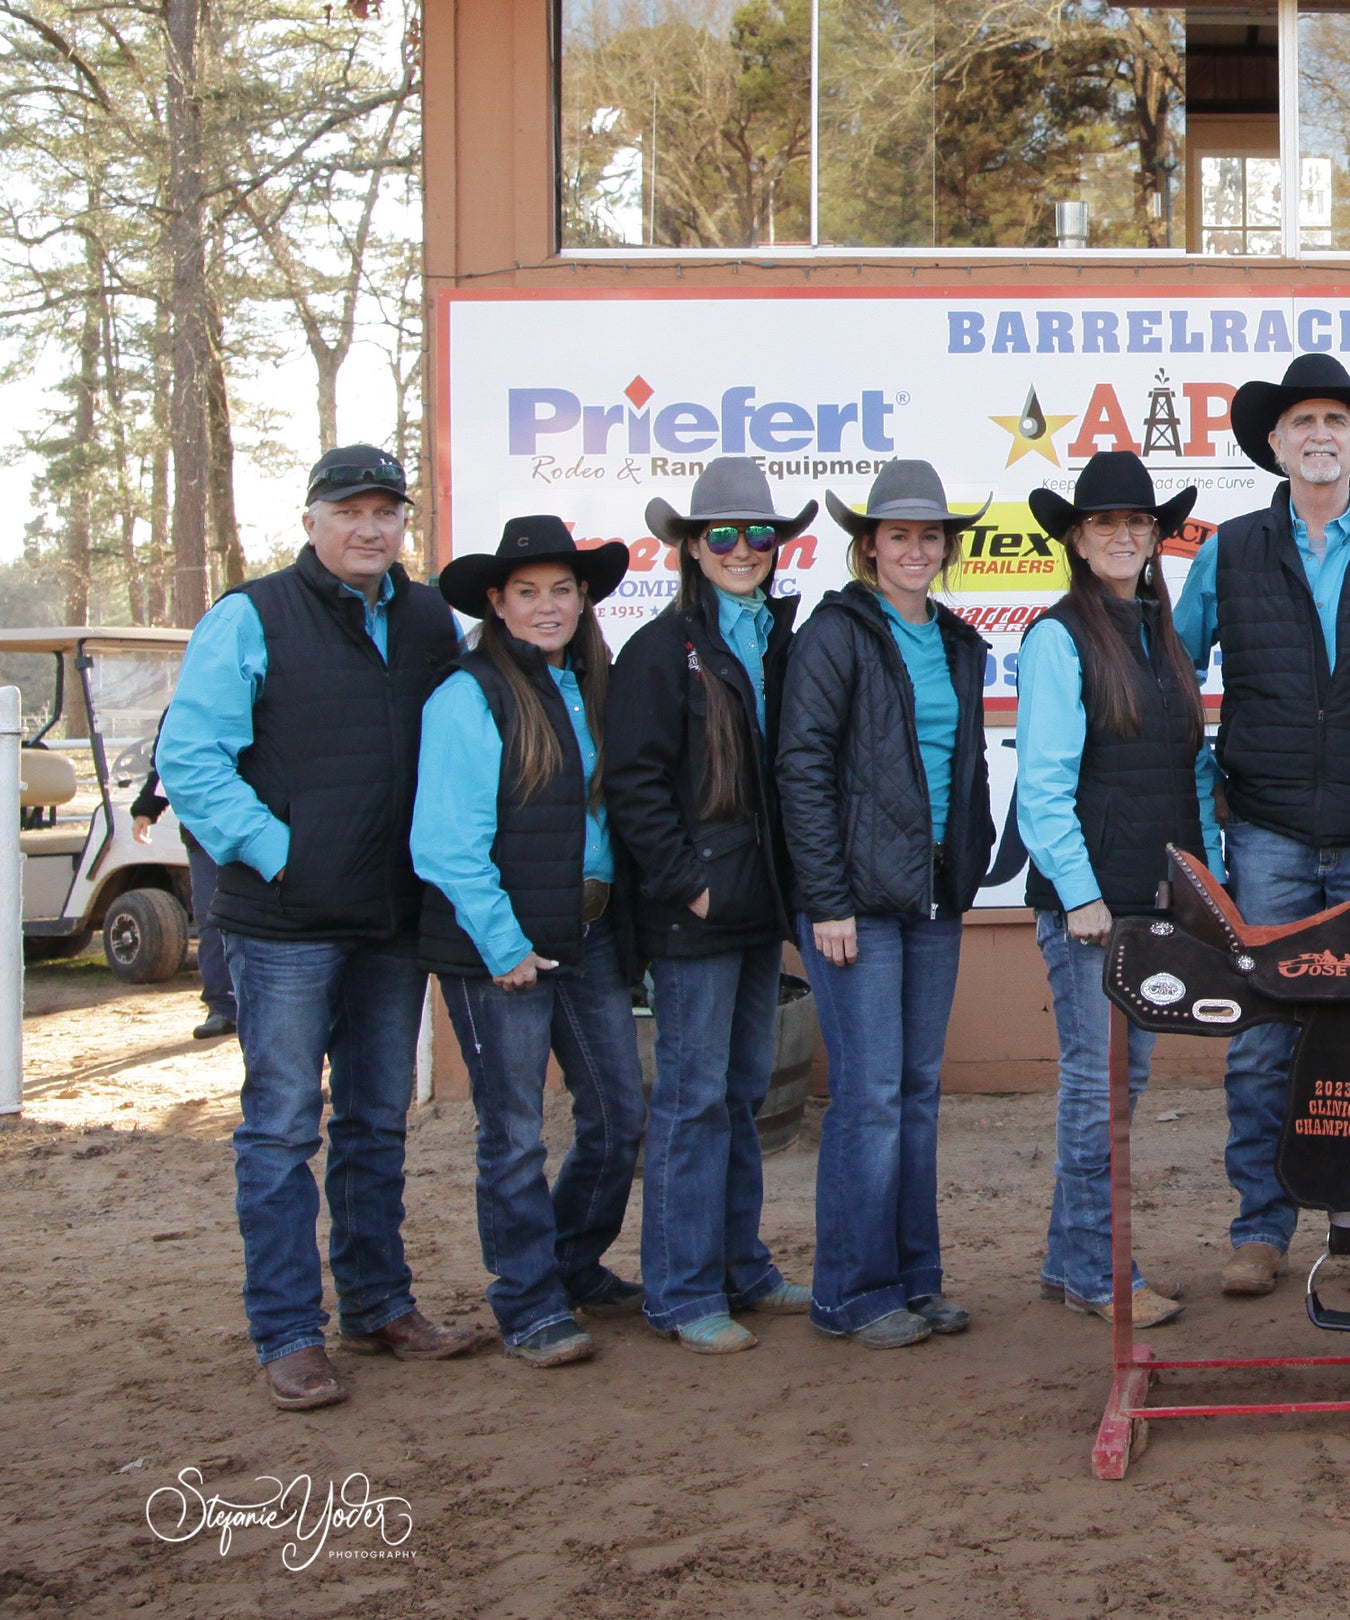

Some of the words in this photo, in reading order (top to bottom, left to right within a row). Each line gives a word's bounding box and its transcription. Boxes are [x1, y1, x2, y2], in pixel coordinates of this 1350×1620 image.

[531, 455, 606, 485] Rodeo
[617, 457, 642, 485] &
[750, 455, 898, 480] Equipmen
[1217, 476, 1256, 489] Curve
[610, 605, 645, 619] 1915
